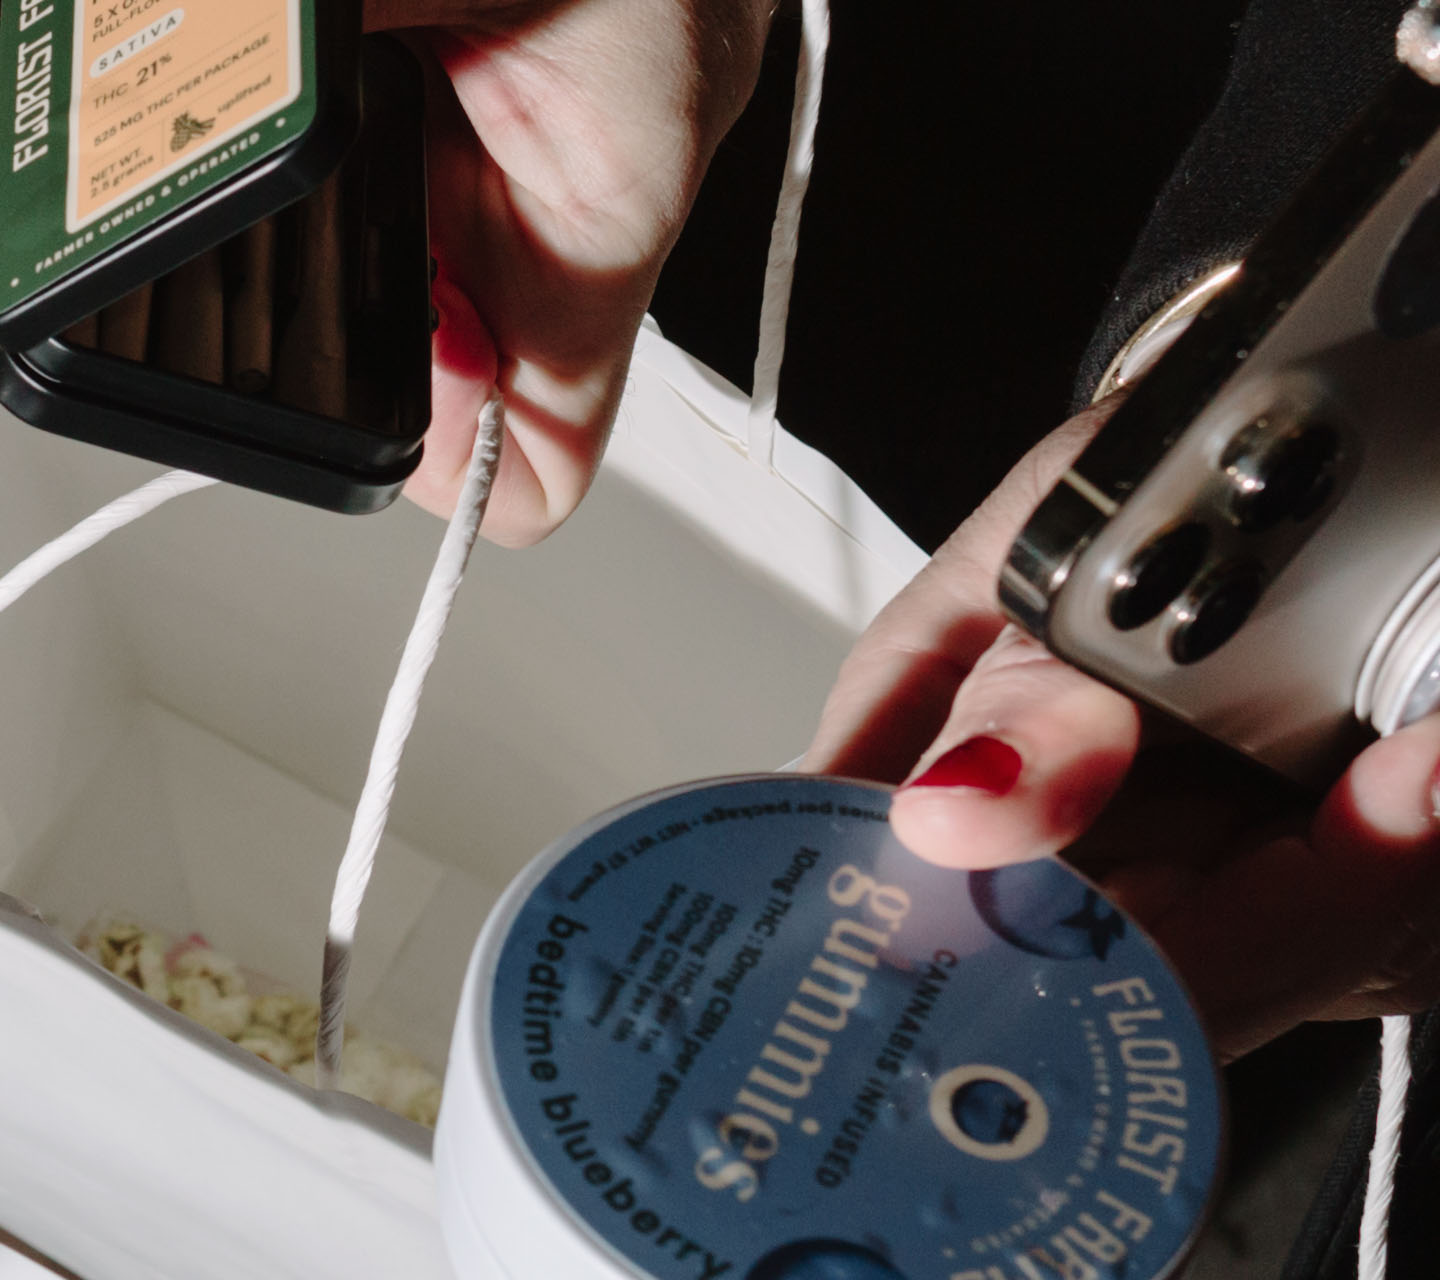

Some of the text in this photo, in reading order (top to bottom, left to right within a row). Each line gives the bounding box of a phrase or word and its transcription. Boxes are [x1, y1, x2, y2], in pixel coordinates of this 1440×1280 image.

[93, 15, 104, 29] 5
[98, 16, 177, 71] SATIVA
[12, 30, 54, 173] FLORIST
[93, 53, 173, 110] THC 21%
[93, 32, 271, 148] 525 MG THC PER PACKAGE
[217, 73, 273, 114] uplifted
[90, 162, 118, 187] NET
[112, 155, 155, 188] grams
[34, 230, 95, 274] FARMER
[99, 194, 156, 235] OWNED
[177, 131, 261, 188] OPERATED
[771, 846, 821, 897] 10mg
[753, 896, 794, 939] THC
[713, 945, 764, 996] 10mg
[523, 913, 589, 1084] bedtime
[694, 995, 732, 1043] CBN
[674, 1035, 702, 1075] per
[694, 863, 912, 1204] gummies
[815, 947, 959, 1189] CANNABIS INFUSED
[1091, 977, 1189, 1195] FLORIST
